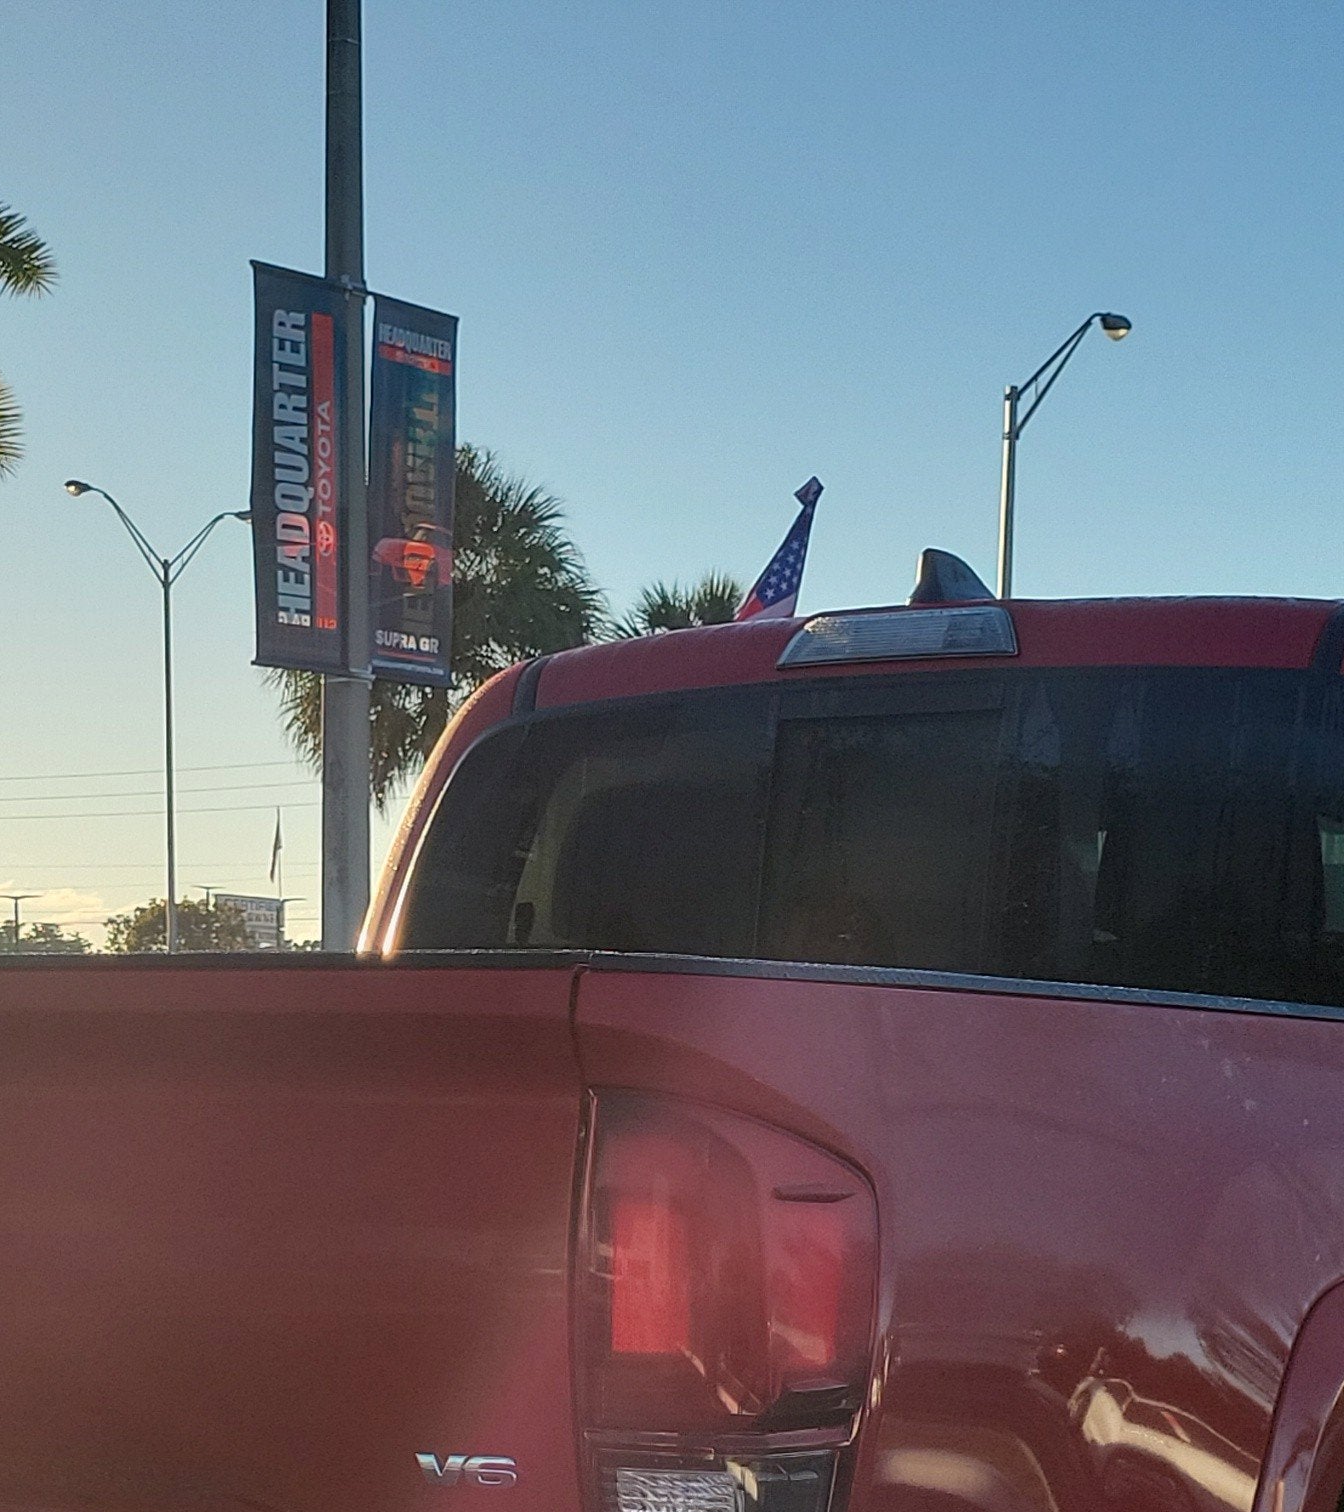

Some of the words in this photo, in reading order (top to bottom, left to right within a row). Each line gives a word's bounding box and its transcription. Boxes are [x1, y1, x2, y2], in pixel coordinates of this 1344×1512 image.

[378, 322, 452, 361] HEADQUARTER
[272, 308, 314, 627] HEADQUARTER
[315, 400, 332, 518] TOYOTA
[375, 629, 417, 651] SUPRA
[419, 636, 440, 654] GR
[415, 1452, 517, 1486] V6
